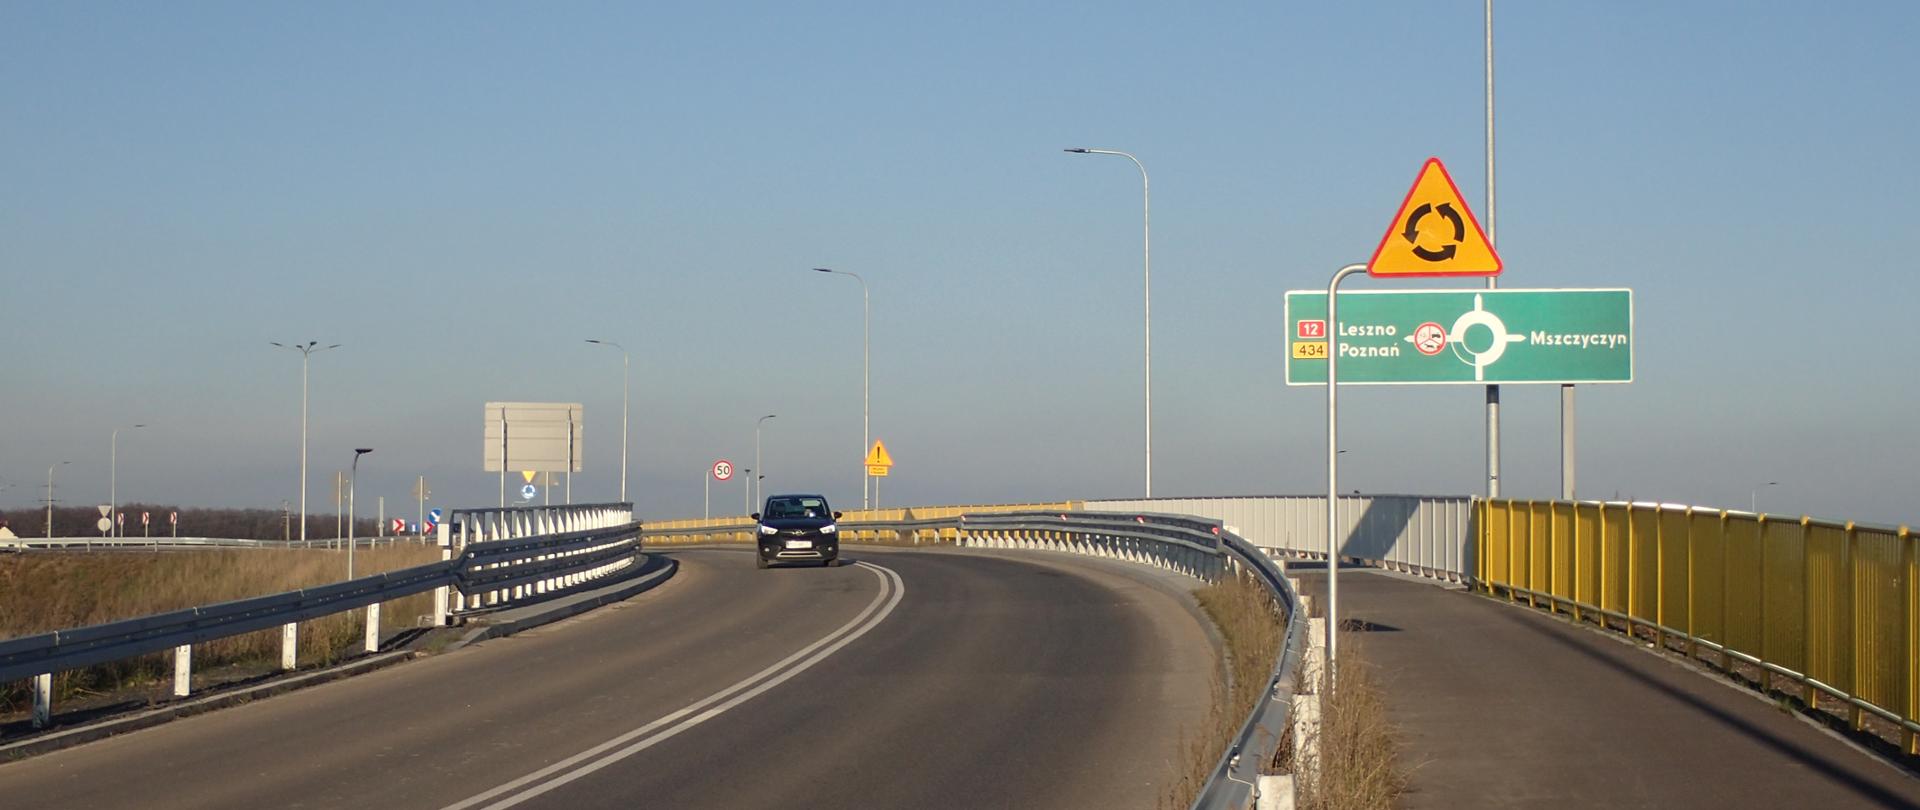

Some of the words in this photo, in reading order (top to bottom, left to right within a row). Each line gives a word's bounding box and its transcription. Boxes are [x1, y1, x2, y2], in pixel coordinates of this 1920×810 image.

[1303, 323, 1318, 335] 12
[1339, 322, 1396, 336] Leszno
[1530, 330, 1627, 349] Mszczyczyn
[1299, 344, 1324, 356] 434
[1339, 342, 1400, 357] Poznań
[717, 465, 730, 475] 50
